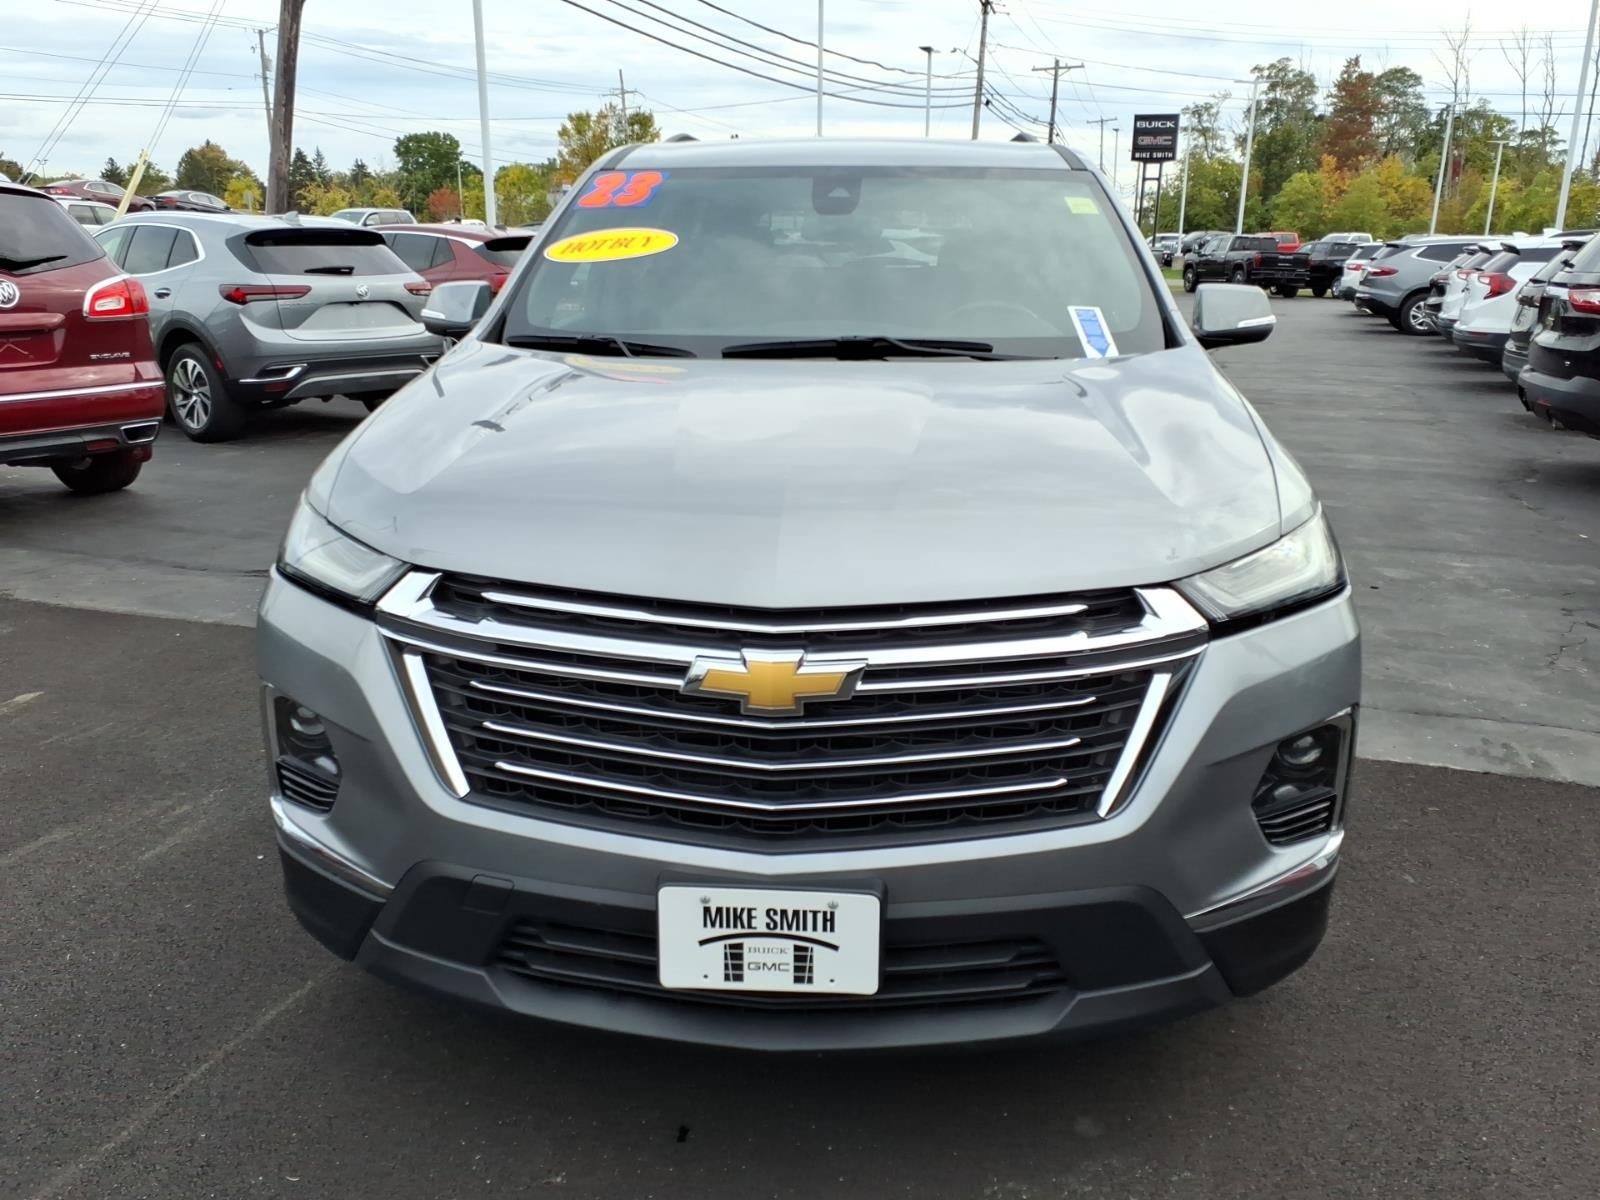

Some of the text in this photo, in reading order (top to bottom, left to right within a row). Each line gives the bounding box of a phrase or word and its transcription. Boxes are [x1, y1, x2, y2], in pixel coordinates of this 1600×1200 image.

[1136, 120, 1175, 128] BUICK
[1138, 136, 1172, 145] GMC
[577, 171, 663, 208] 23
[560, 238, 610, 255] HOT
[703, 906, 836, 933] MIKE SMITH
[748, 945, 790, 954] BUICK
[747, 961, 790, 972] GMC
